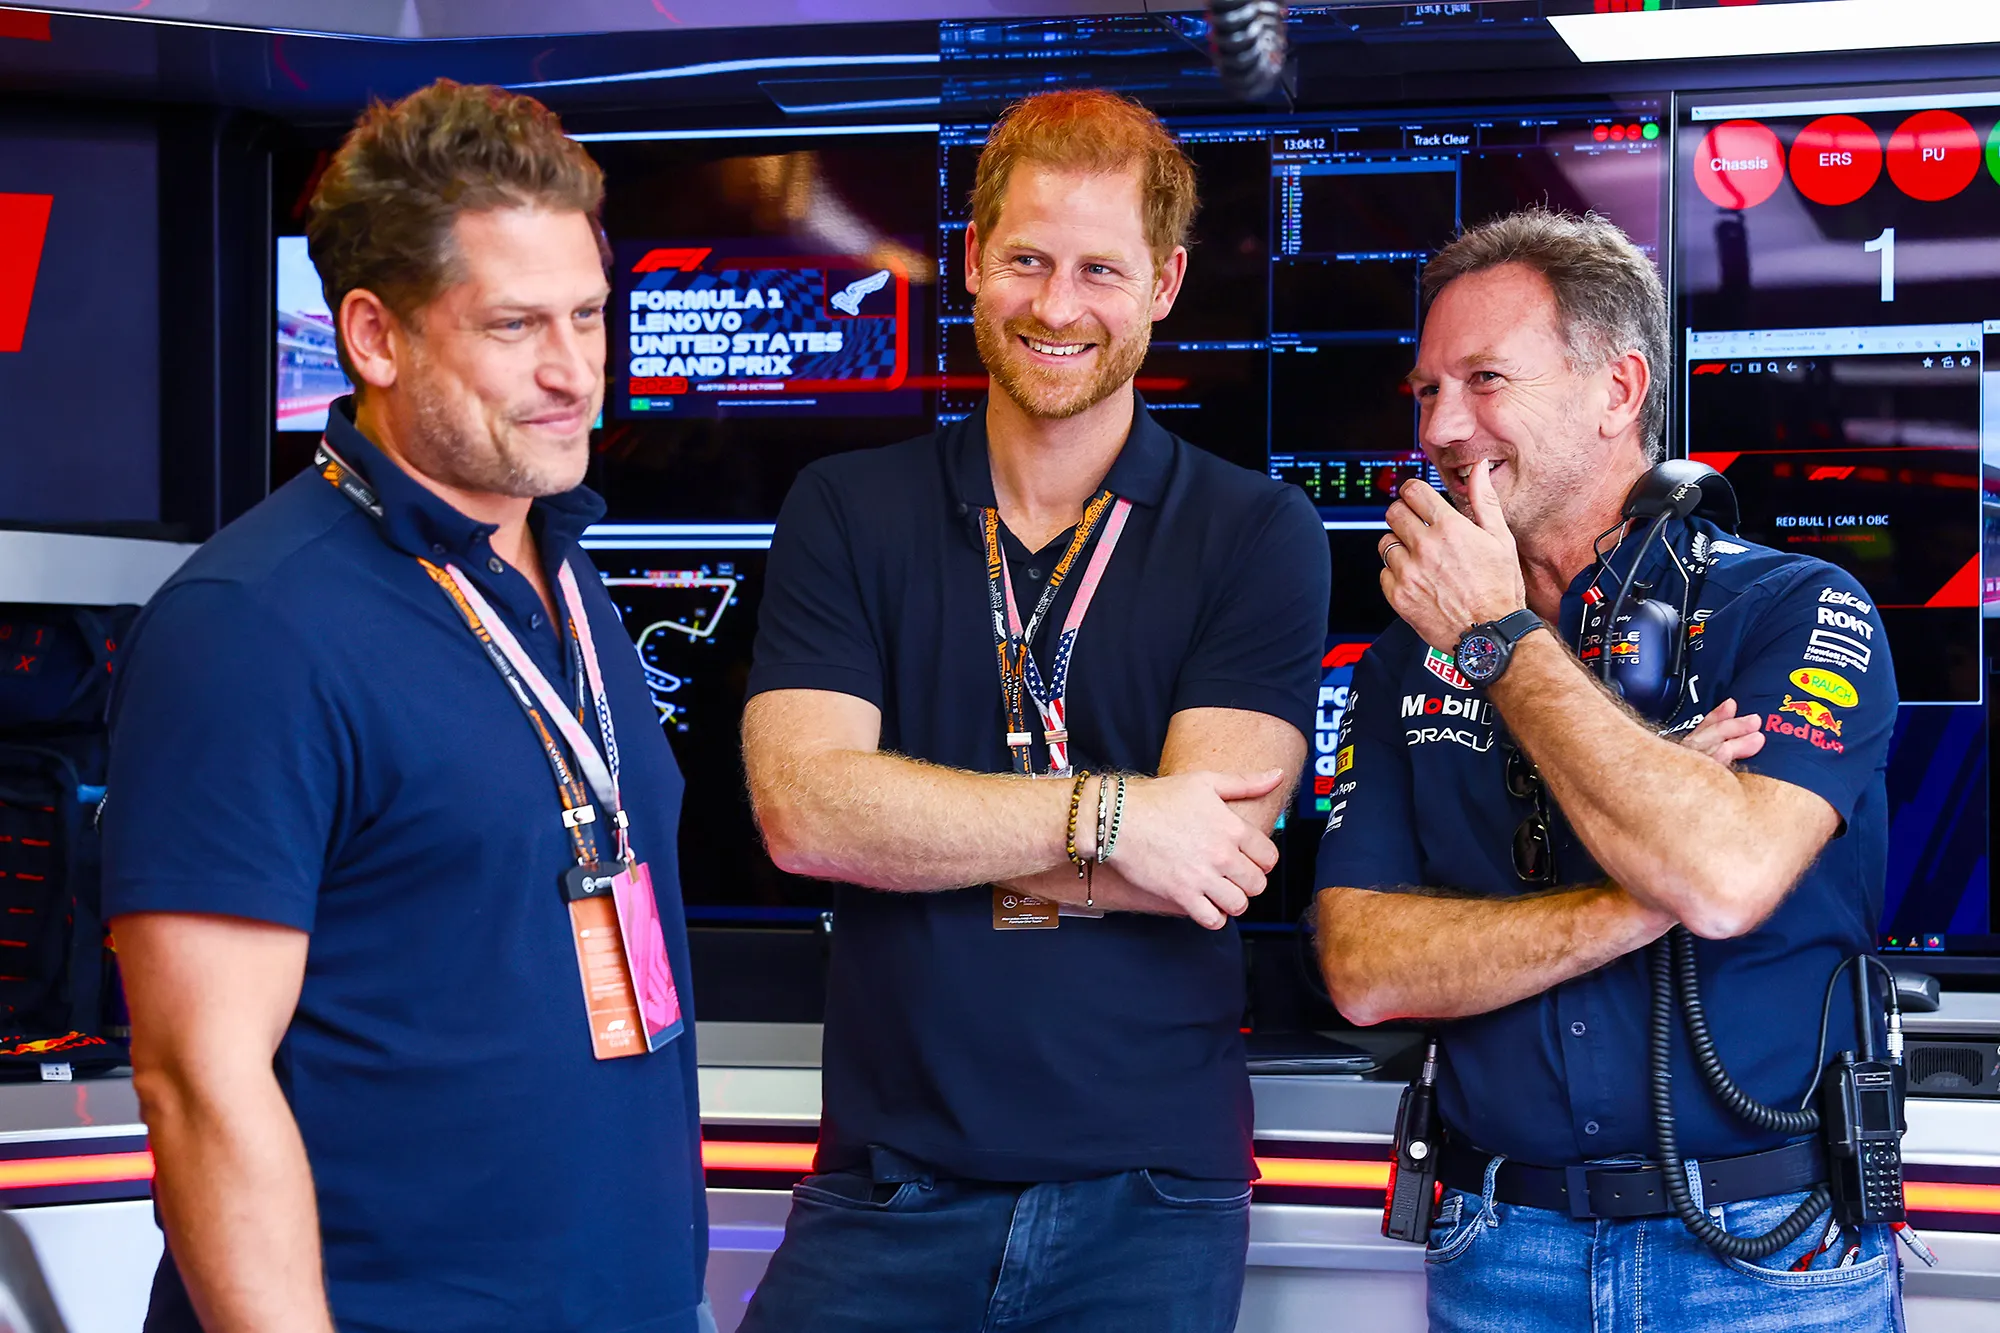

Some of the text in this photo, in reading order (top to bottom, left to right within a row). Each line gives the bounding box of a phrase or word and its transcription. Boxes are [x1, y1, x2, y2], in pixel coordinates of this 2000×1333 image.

[1283, 138, 1325, 150] 13:04:12
[1413, 134, 1470, 146] Track Clear
[1710, 156, 1768, 172] Chassis
[1819, 152, 1852, 166] ERS
[1922, 147, 1945, 162] PU
[1864, 227, 1895, 302] 1
[630, 288, 784, 311] FORMULA 1
[630, 311, 742, 333] LENOVO
[630, 331, 843, 355] UNITED STATES
[629, 354, 793, 377] GRAND PRIX
[630, 379, 686, 393] 2023
[1776, 516, 1797, 527] RED
[1798, 516, 1824, 527] BULL
[1834, 515, 1856, 526] CAR
[1858, 515, 1863, 525] 1
[1866, 514, 1889, 526] OBC
[1060, 545, 1076, 569] UNITED
[1074, 520, 1091, 546] STATES
[1817, 586, 1872, 615] telcel
[1616, 614, 1632, 622] poly
[1816, 606, 1874, 641] ROKT
[1805, 645, 1842, 662] Hewlett
[1429, 659, 1472, 687] HEU
[1012, 674, 1020, 714] SUNDAY
[1811, 674, 1851, 702] RAUCH
[1401, 693, 1480, 722] Mobil
[1405, 727, 1494, 752] ORACLE
[1764, 713, 1845, 754] Red Bull
